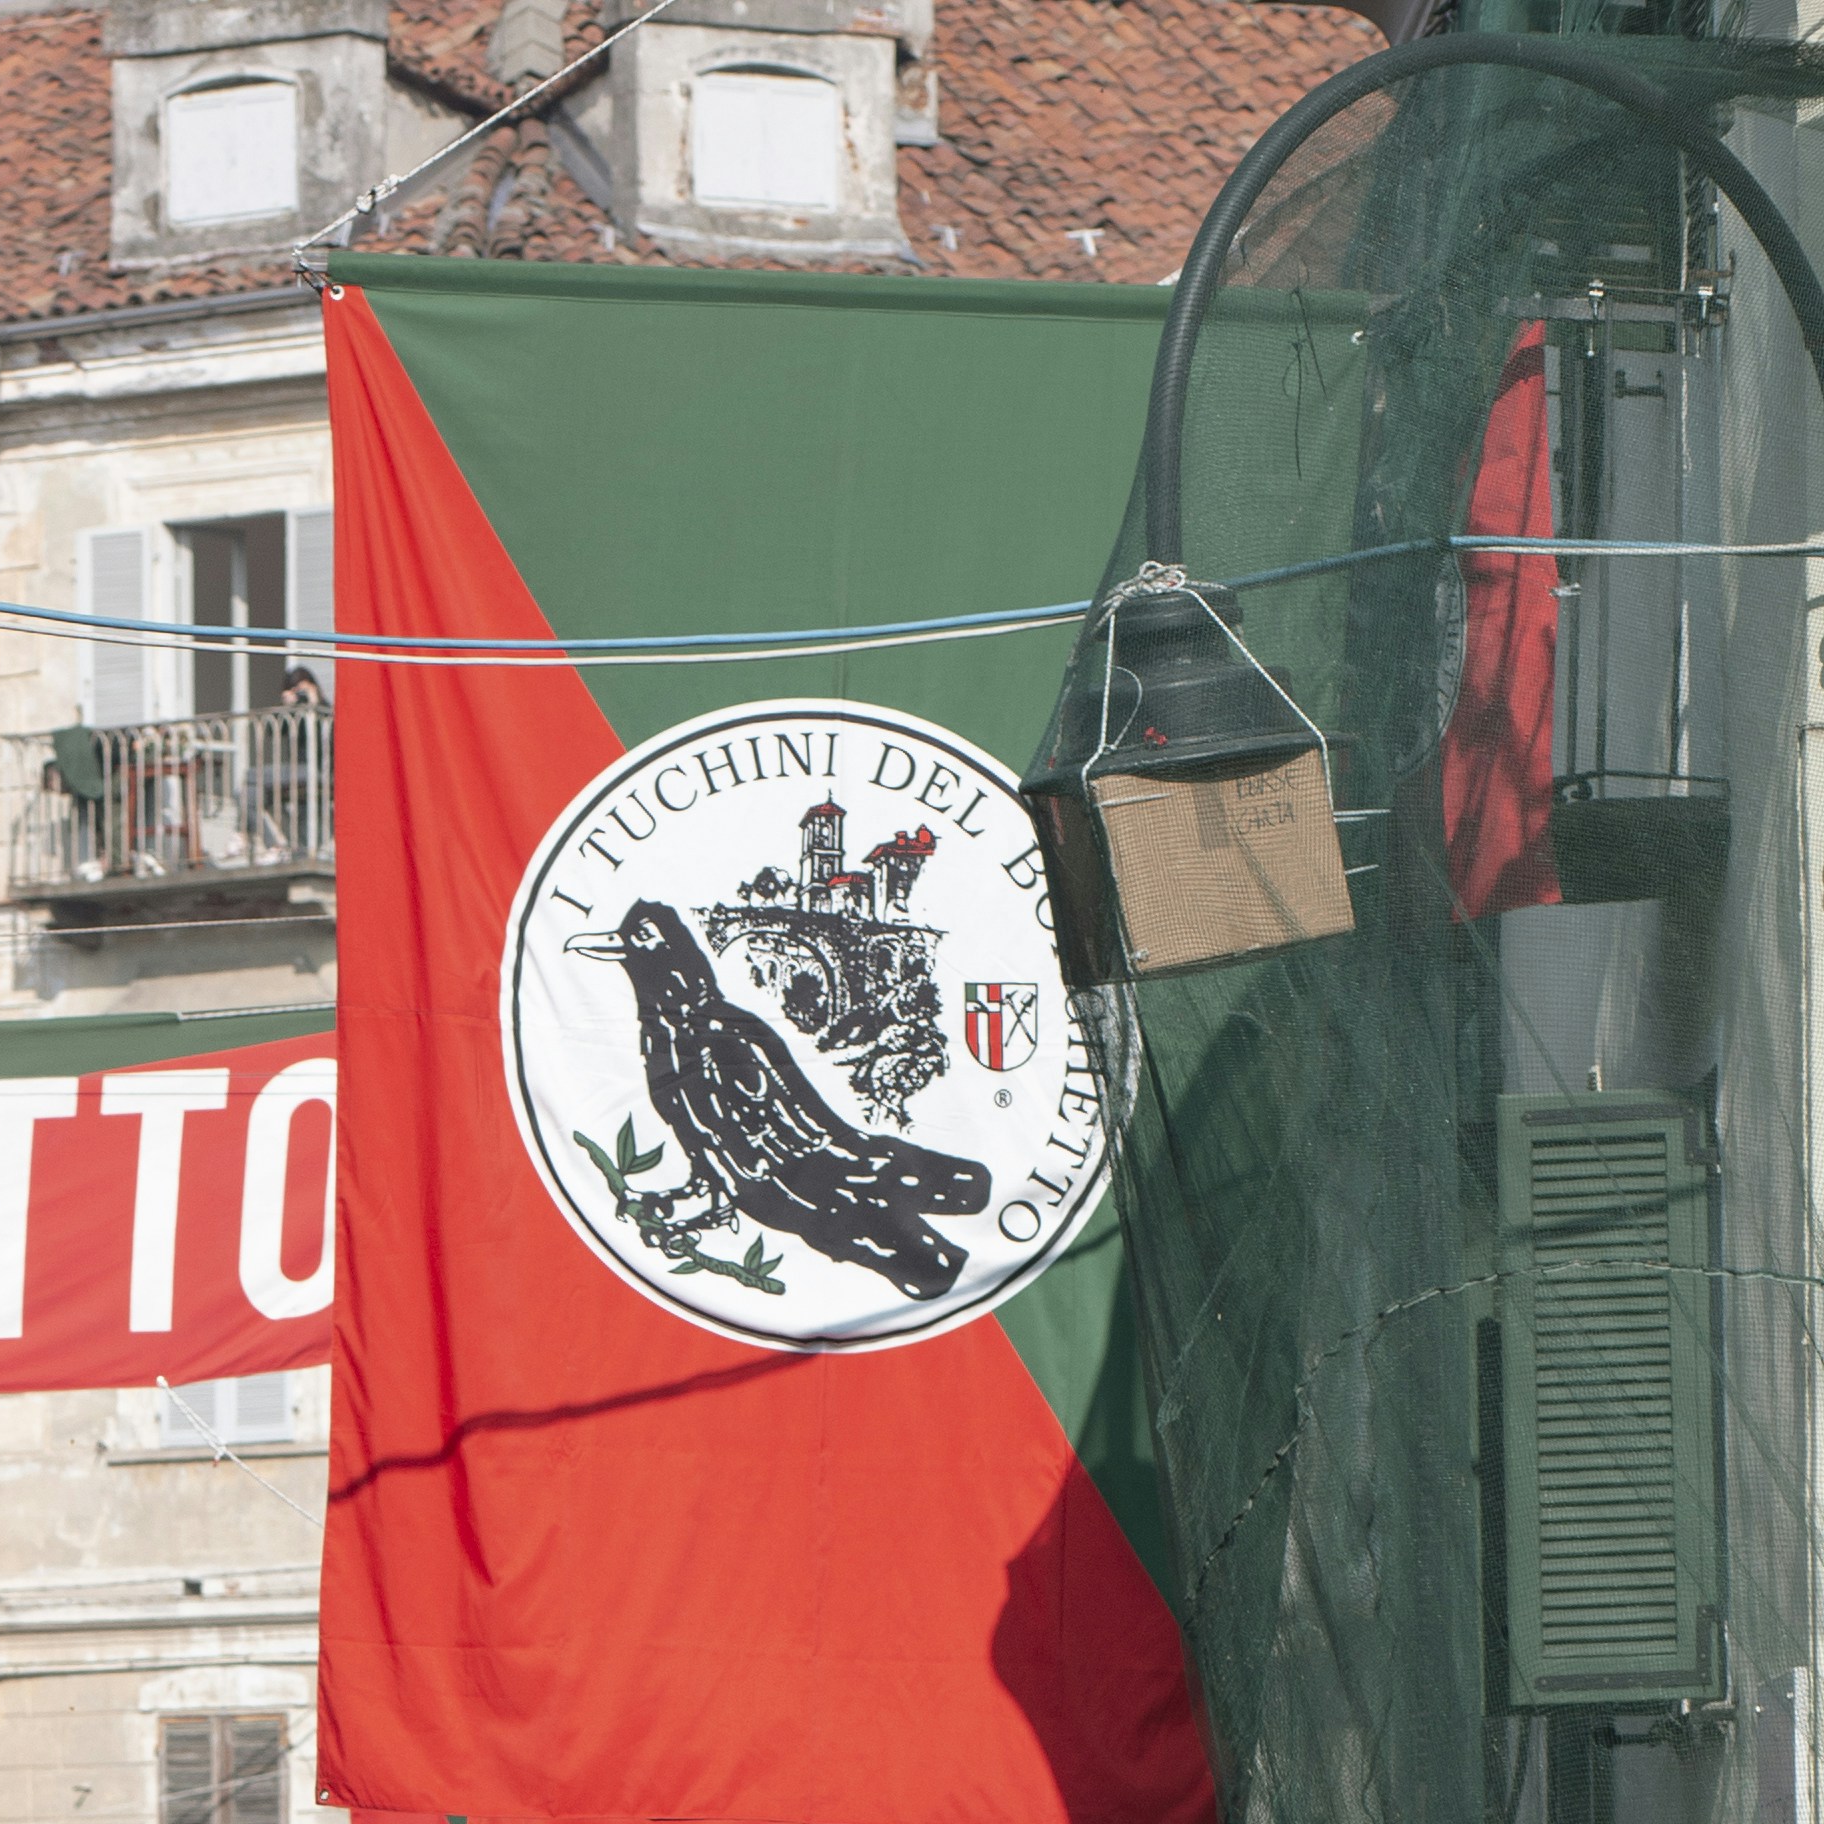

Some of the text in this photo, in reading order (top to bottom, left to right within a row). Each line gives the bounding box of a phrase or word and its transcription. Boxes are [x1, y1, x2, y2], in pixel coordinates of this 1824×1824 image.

[551, 732, 1107, 1243] I TUCHINI DEL BGHETTO
